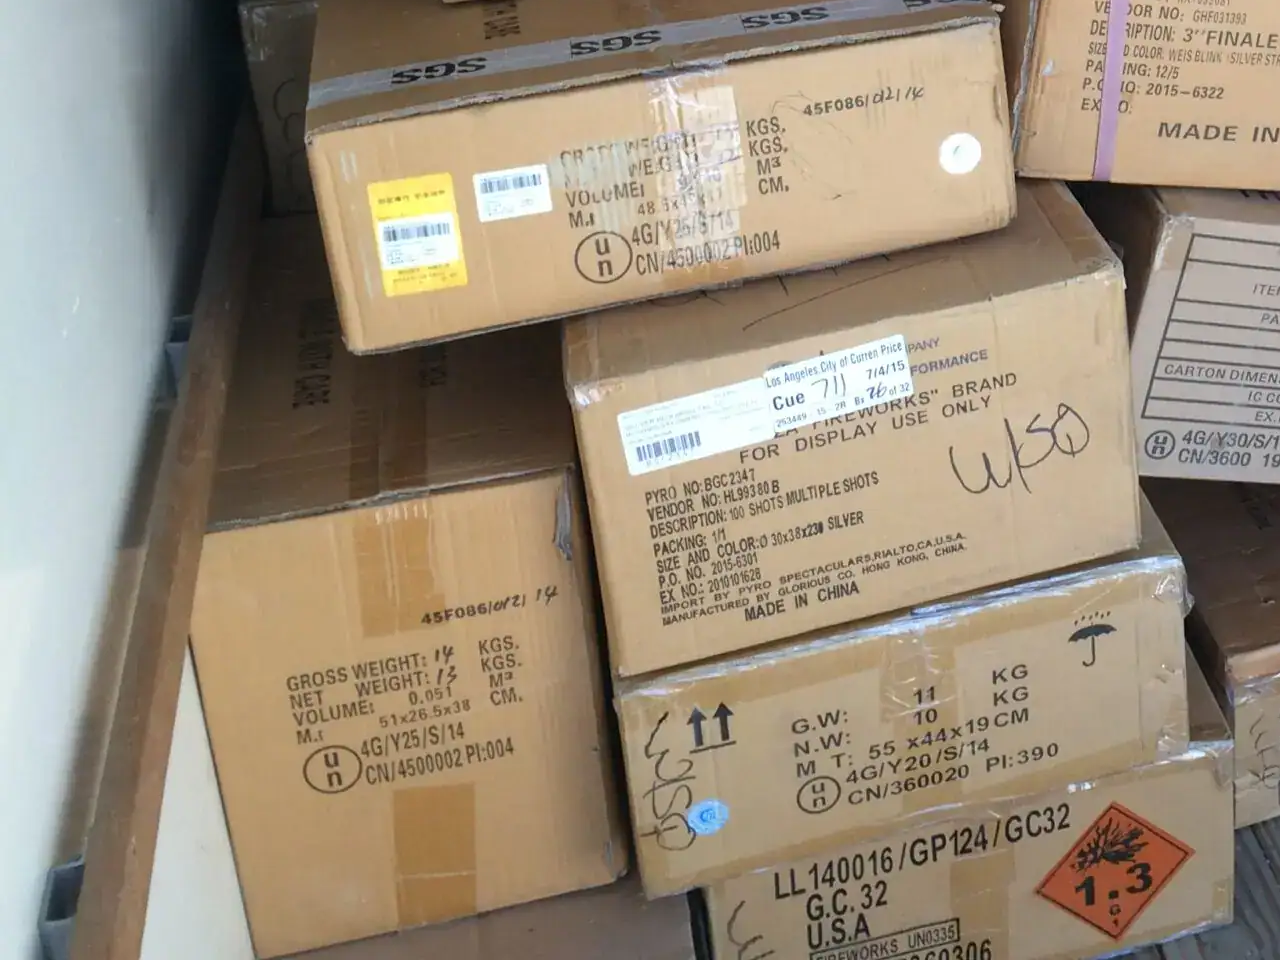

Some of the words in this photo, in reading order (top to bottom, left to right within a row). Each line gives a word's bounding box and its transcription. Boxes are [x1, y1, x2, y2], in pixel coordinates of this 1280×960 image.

[746, 116, 786, 137] KGS.
[1158, 122, 1239, 141] MADE
[1252, 126, 1280, 143] IN
[749, 136, 789, 156] KGS.
[866, 361, 905, 380] 7/4/15
[1164, 363, 1225, 381] CARTON
[952, 373, 1017, 398] BRAND
[772, 391, 805, 411] Cue
[739, 444, 779, 464] FOR
[795, 421, 877, 452] DISPLAY
[892, 411, 928, 430] USE
[942, 395, 992, 418] ONLY
[645, 487, 677, 505] PYRO
[749, 497, 784, 516] SHOTS
[786, 486, 842, 506] MULTIPLE
[843, 471, 879, 492] SHOTS
[646, 502, 695, 521] VENDOR
[827, 511, 865, 531] SILVER
[656, 558, 681, 573] SIZE
[688, 550, 711, 566] AND
[744, 600, 785, 621] MADE
[817, 581, 860, 602] CHINA
[286, 666, 348, 692] GROSS
[352, 653, 427, 680] WEIGHT:
[478, 635, 520, 656] KGS.
[991, 665, 1028, 684] KG
[289, 689, 324, 709] NET
[355, 671, 430, 697] WEIGHT:
[480, 653, 523, 673] KGS.
[913, 708, 938, 726] 10
[993, 686, 1029, 706] KG
[807, 912, 870, 951] U.S.A
[907, 924, 955, 950] UN0335
